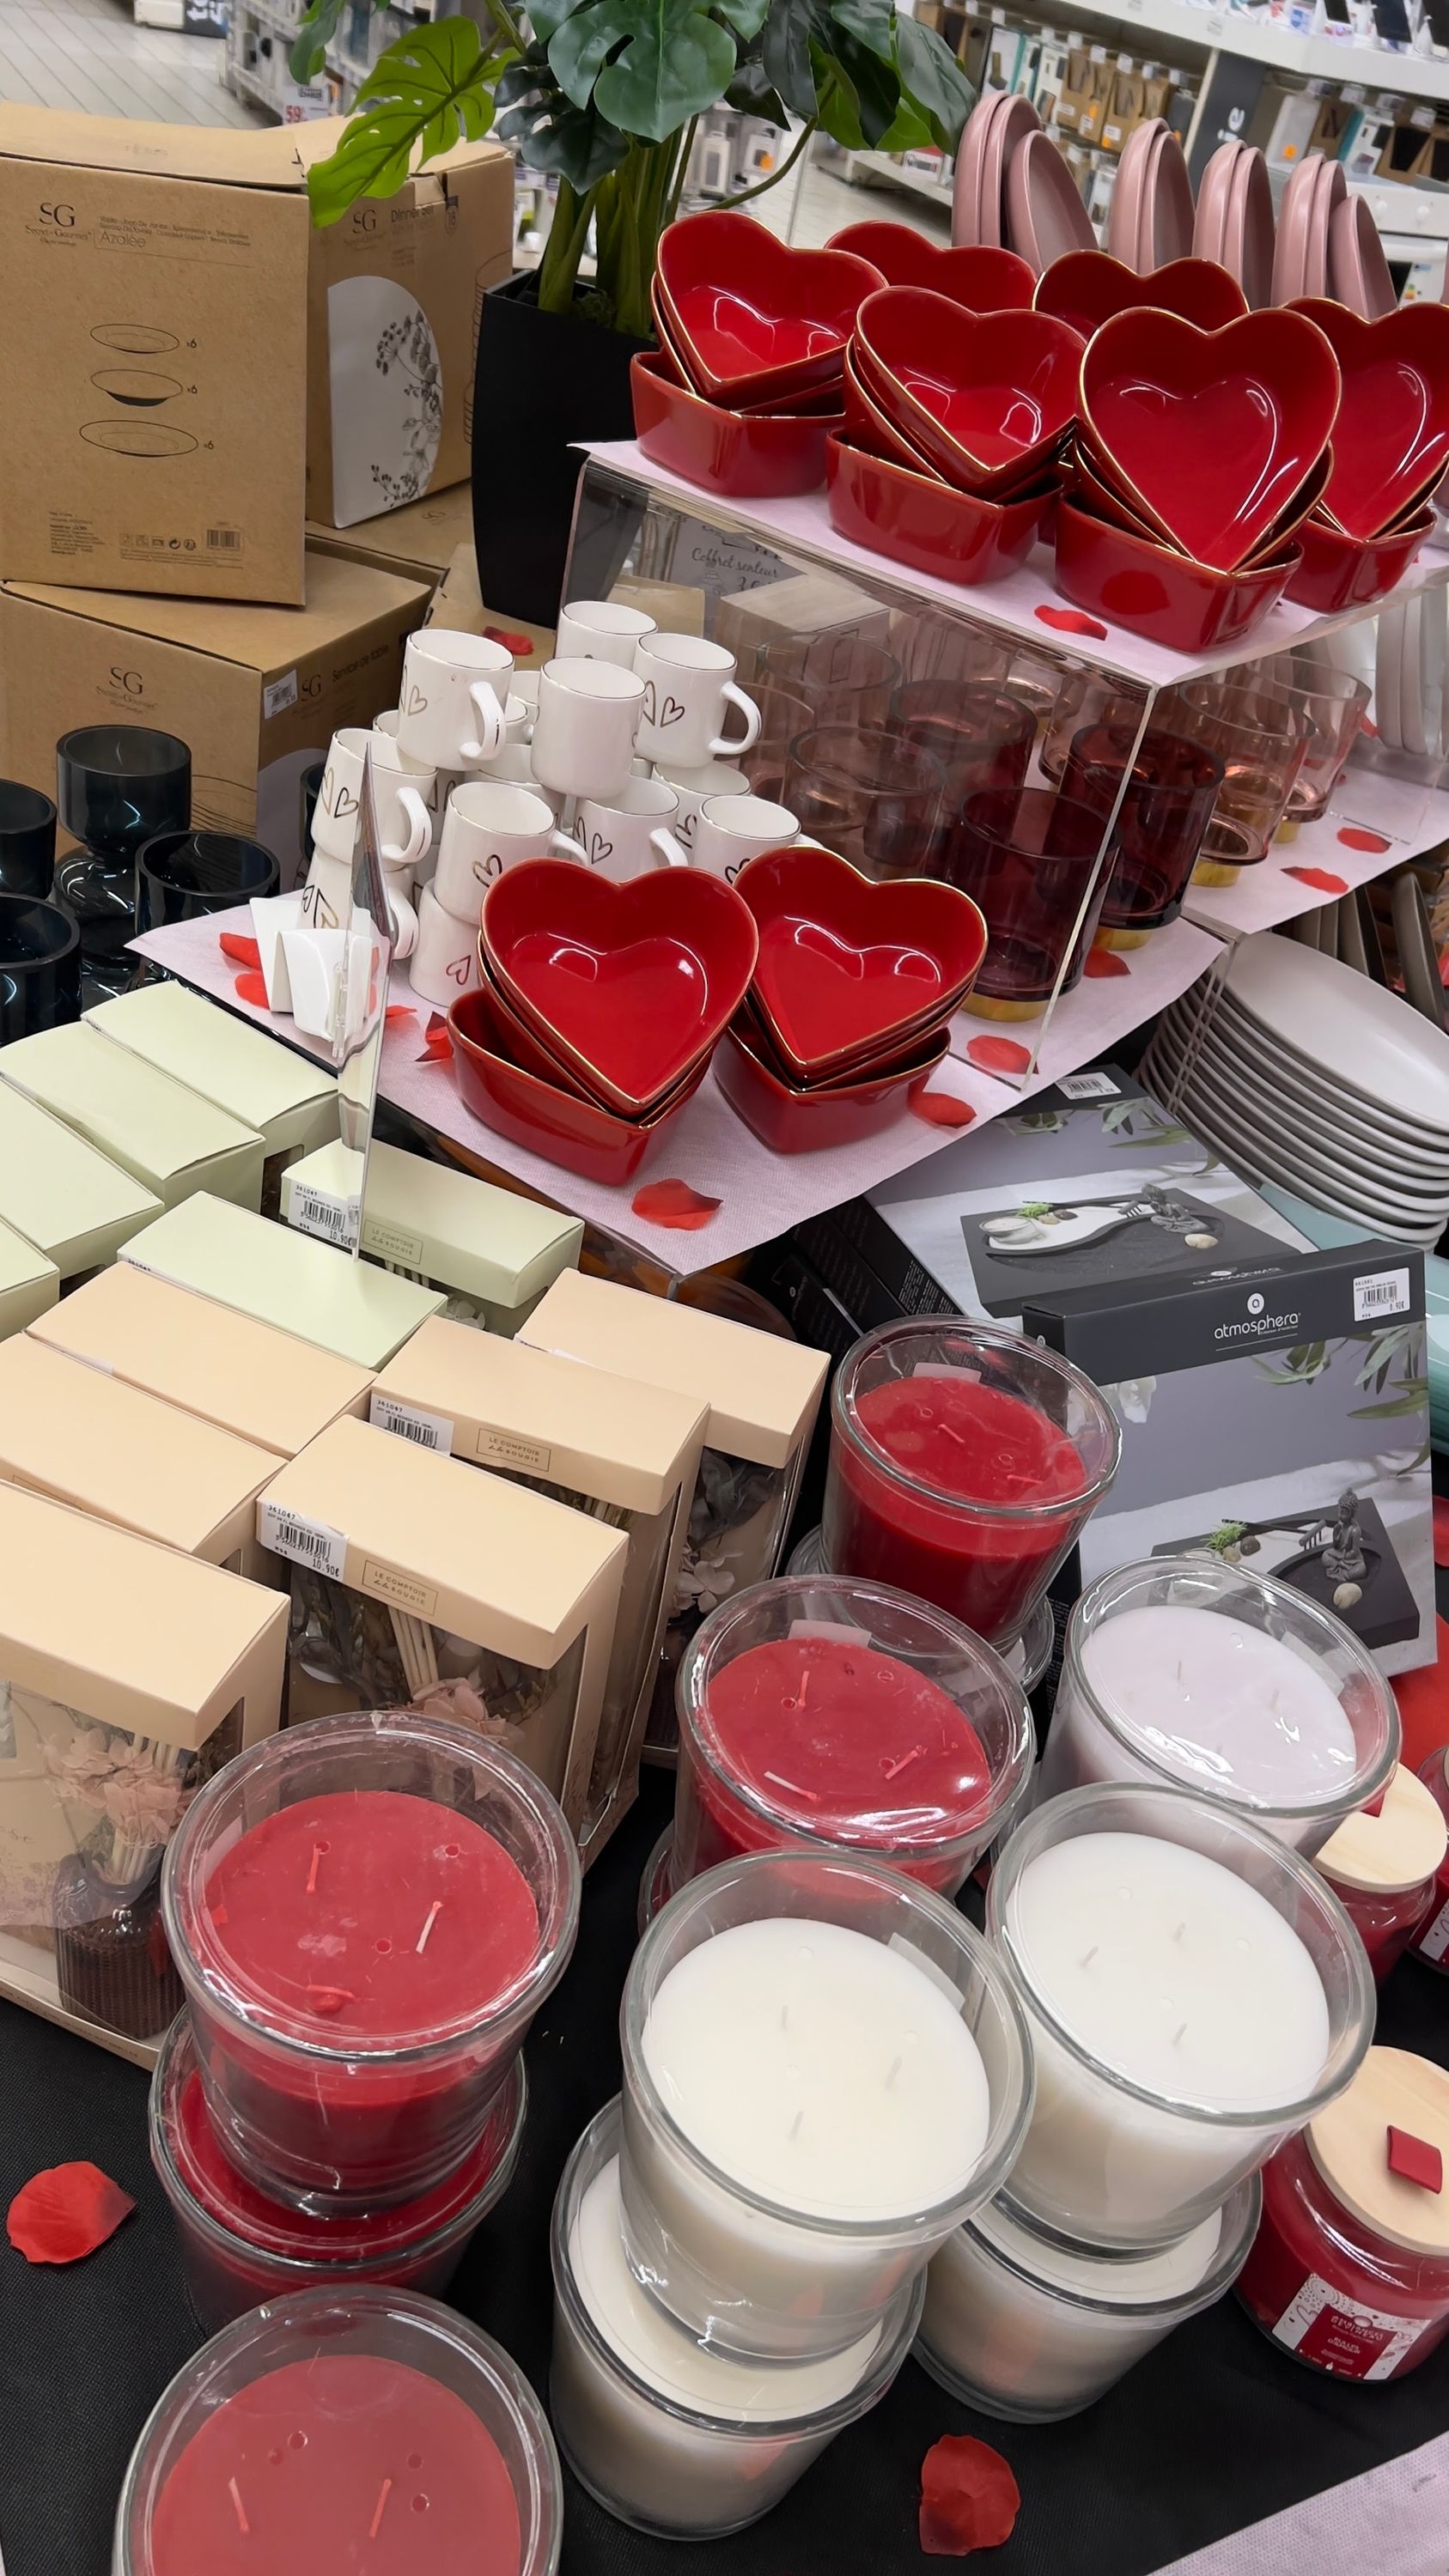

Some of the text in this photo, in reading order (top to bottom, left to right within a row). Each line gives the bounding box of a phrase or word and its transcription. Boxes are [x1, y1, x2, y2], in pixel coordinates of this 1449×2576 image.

[39, 201, 76, 228] SG
[352, 209, 376, 234] SG
[109, 666, 143, 694] SG
[301, 674, 321, 702] SG
[1215, 1314, 1299, 1340] atmosphera
[312, 1558, 340, 1577] 10.90€
